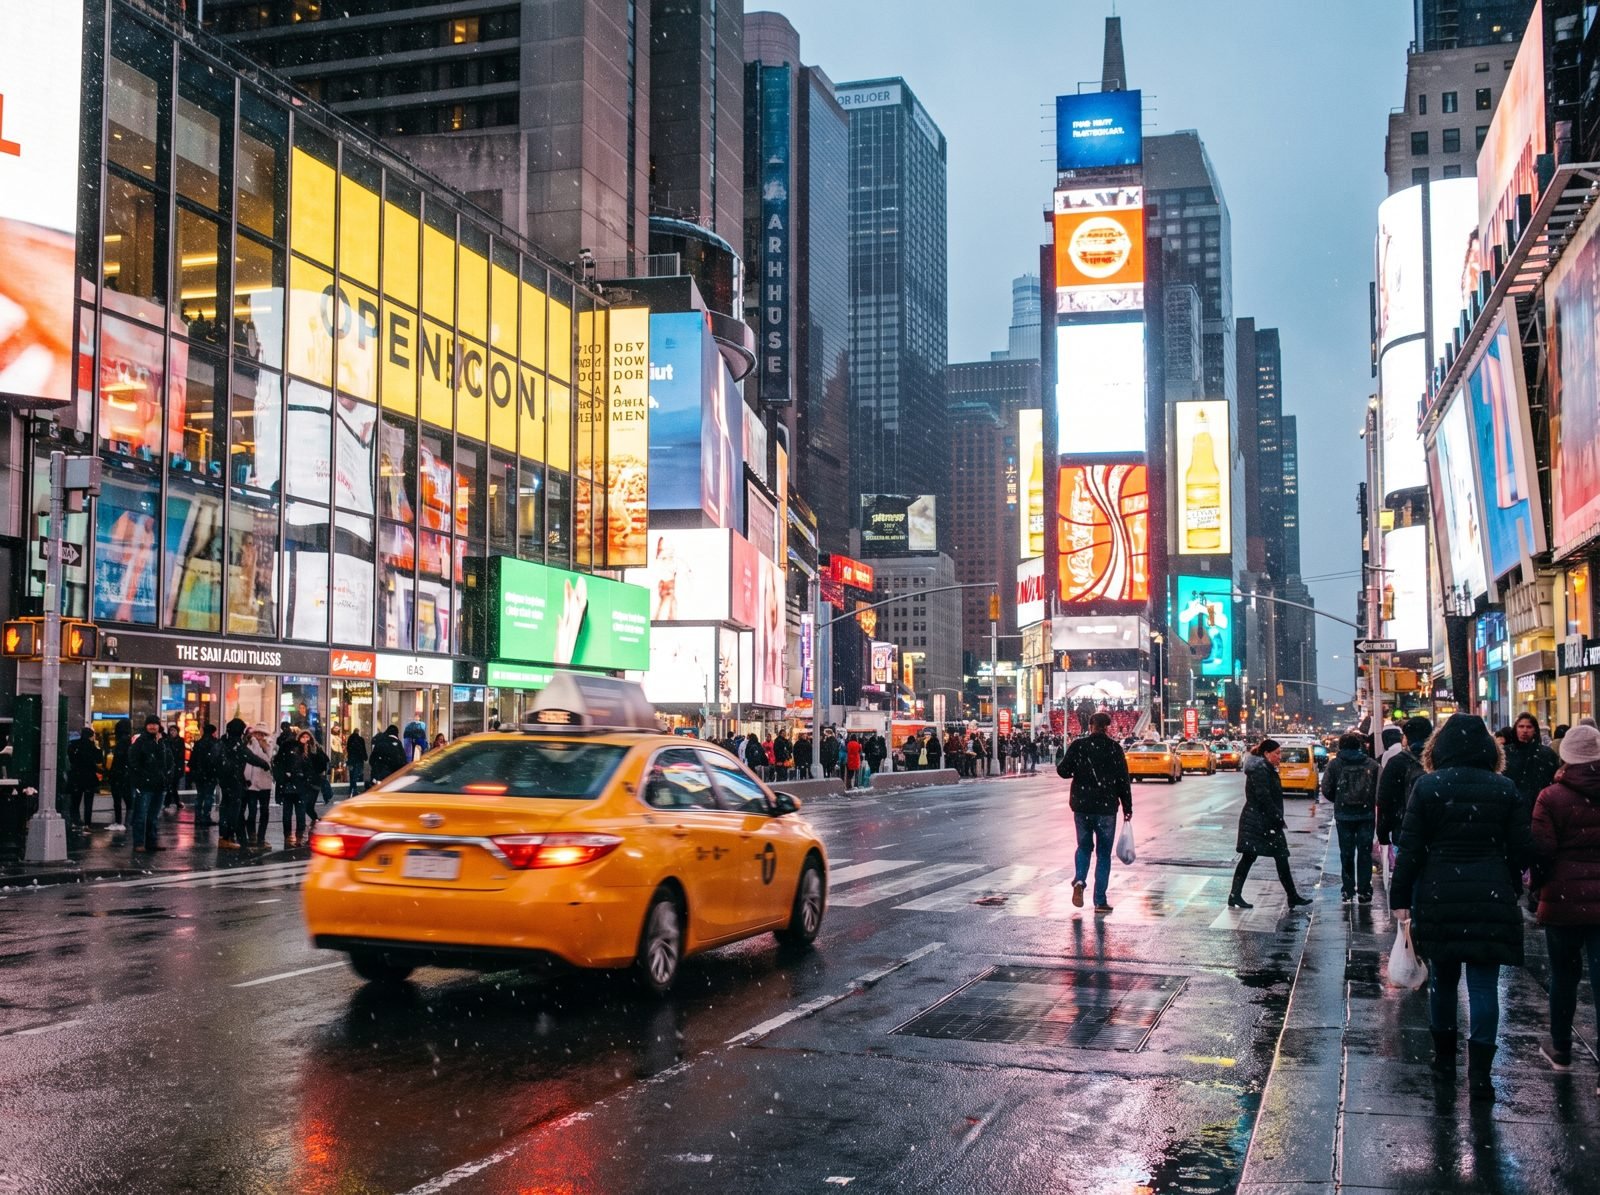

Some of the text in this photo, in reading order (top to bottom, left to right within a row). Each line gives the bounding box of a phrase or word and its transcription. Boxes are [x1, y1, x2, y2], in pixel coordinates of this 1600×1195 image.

[614, 355, 645, 366] NOW
[613, 385, 622, 394] A
[612, 410, 645, 421] MEN
[176, 644, 198, 661] THE
